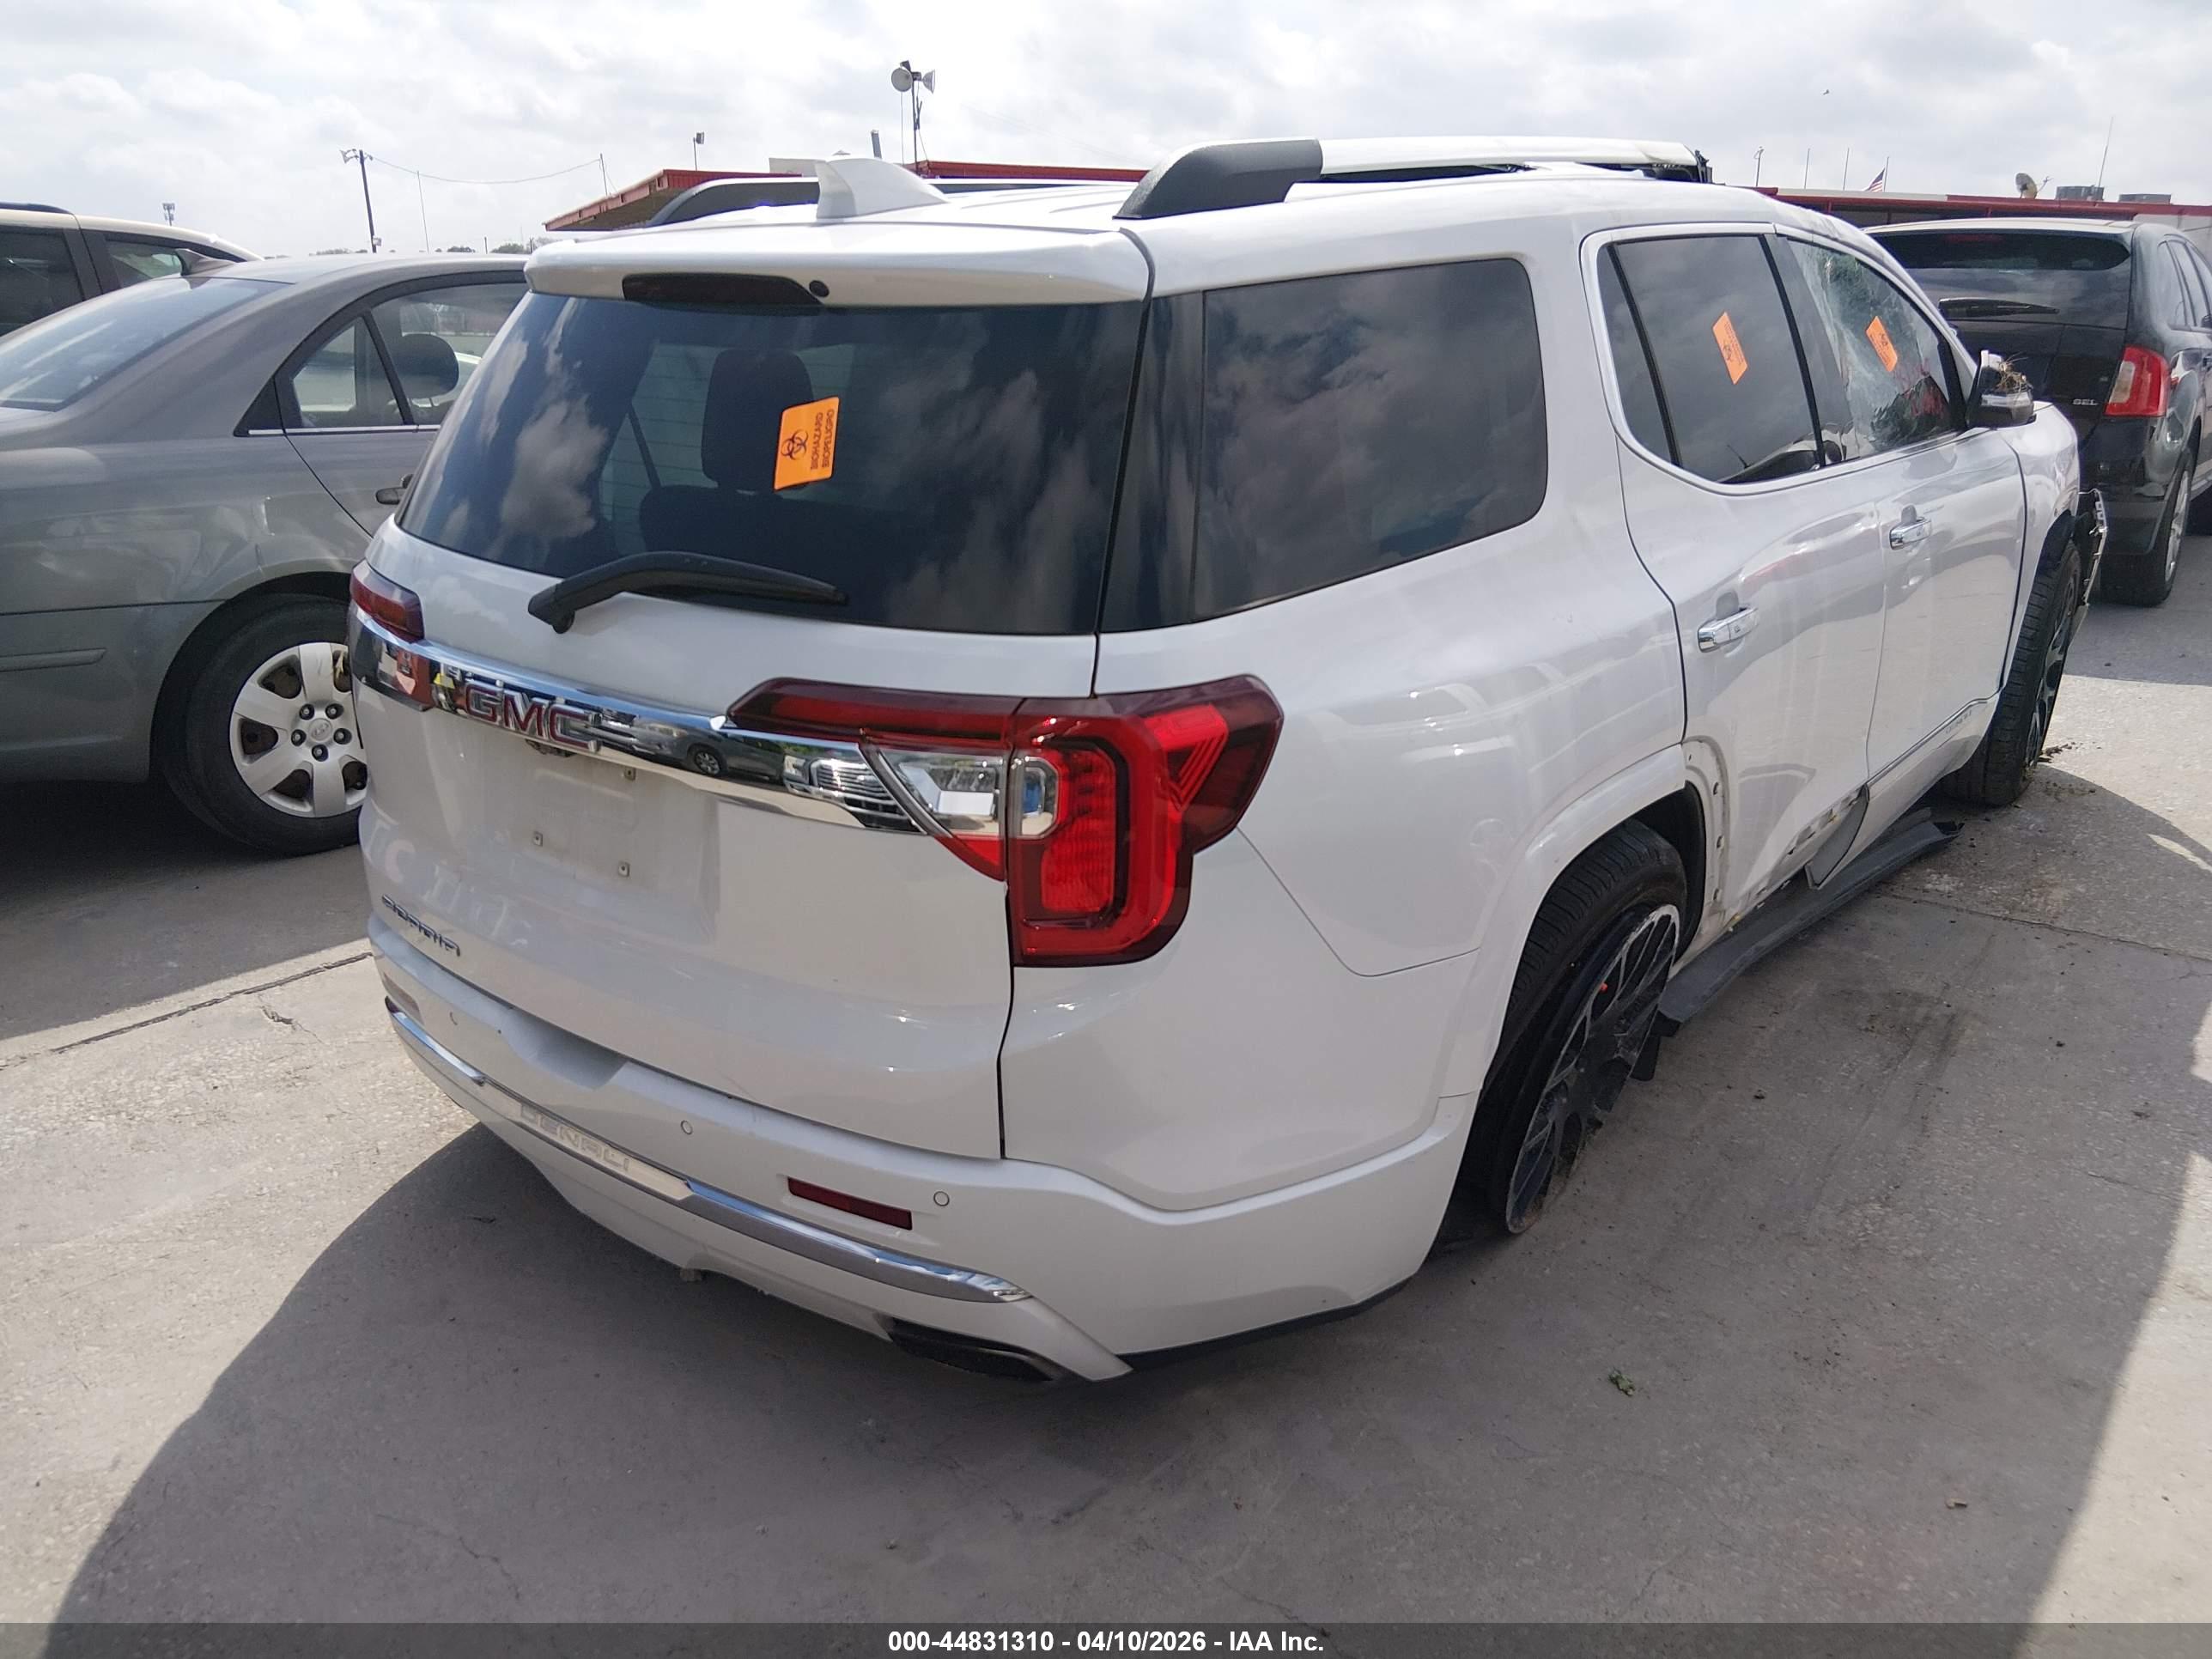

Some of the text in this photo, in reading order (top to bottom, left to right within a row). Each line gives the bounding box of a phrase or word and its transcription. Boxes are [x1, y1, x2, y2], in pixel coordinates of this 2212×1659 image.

[810, 412, 823, 470] BIOHAZARD
[465, 679, 599, 754] GMC
[520, 1101, 631, 1173] DENALI
